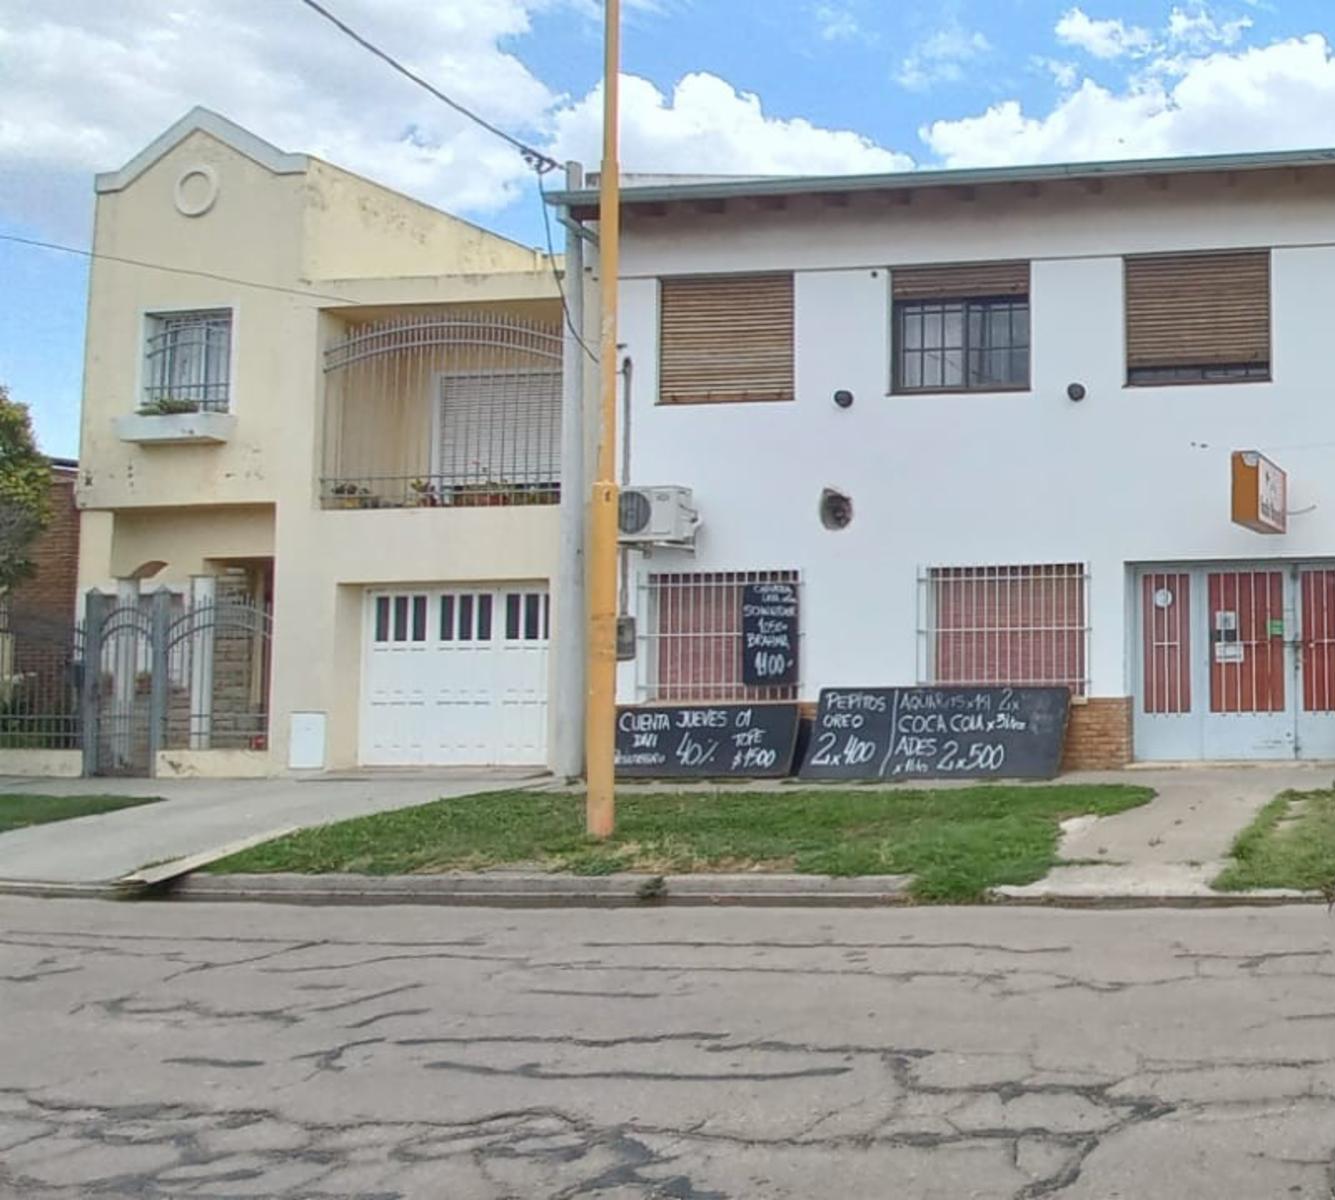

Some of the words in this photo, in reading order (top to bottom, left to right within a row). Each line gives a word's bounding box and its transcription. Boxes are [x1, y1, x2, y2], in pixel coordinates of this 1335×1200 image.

[826, 692, 886, 712] PEPITOS
[619, 712, 670, 731] CUENTA
[676, 709, 728, 728] JUEVES
[735, 708, 751, 726] 01
[823, 714, 863, 729] OREO
[898, 714, 947, 733] COCA
[731, 728, 766, 746] TOPE
[894, 735, 937, 756] ADES
[676, 732, 719, 765] 40%
